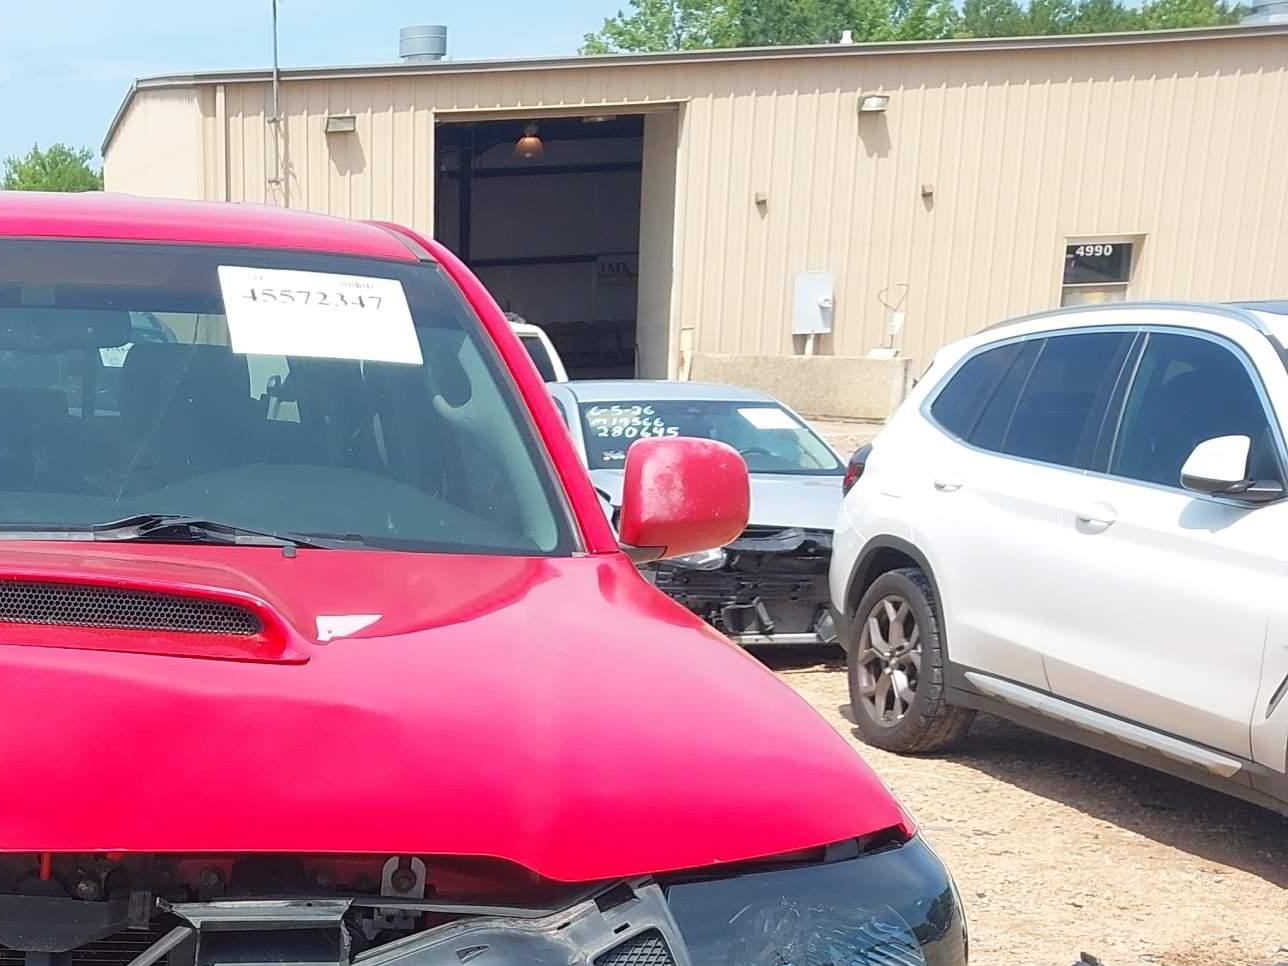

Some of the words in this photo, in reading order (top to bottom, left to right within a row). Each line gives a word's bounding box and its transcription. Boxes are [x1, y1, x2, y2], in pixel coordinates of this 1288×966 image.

[1075, 244, 1113, 257] 4990
[242, 287, 383, 310] 45572347
[597, 425, 681, 438] 280645
